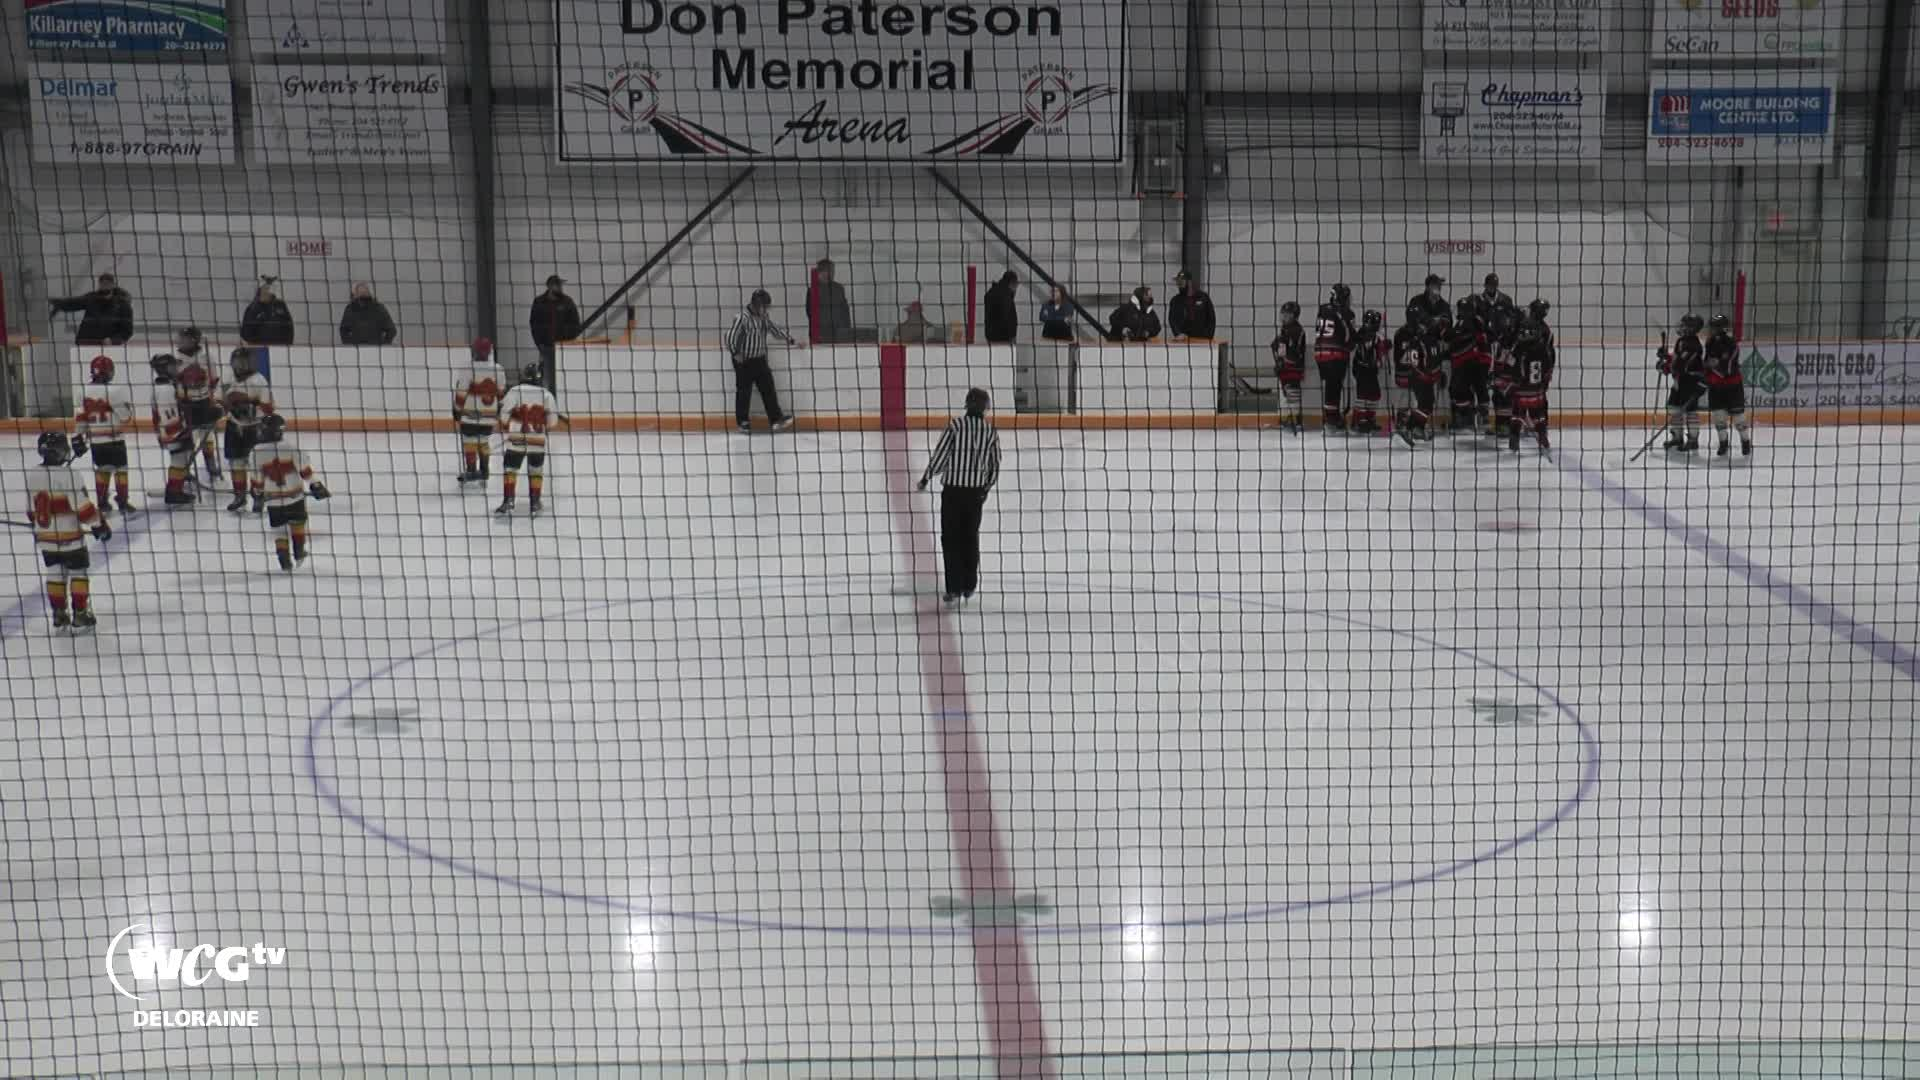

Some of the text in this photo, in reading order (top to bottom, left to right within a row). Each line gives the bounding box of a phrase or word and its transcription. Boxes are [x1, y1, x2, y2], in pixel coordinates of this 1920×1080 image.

[29, 15, 186, 39] Killarney Pharmacy
[622, 0, 1061, 36] Don Paterson
[712, 49, 973, 89] Memorial
[40, 79, 118, 97] Delmar
[283, 74, 441, 97] Gwen's Trends
[1481, 83, 1584, 109] Chapman's
[629, 90, 643, 111] P
[1042, 90, 1056, 110] P
[1700, 97, 1820, 111] MOORE BUILDING
[773, 99, 911, 145] Arena
[1718, 111, 1769, 124] CENTRE
[289, 242, 332, 254] HOME
[1426, 241, 1483, 254] VISITORS
[1796, 353, 1876, 376] SHUR-GRO
